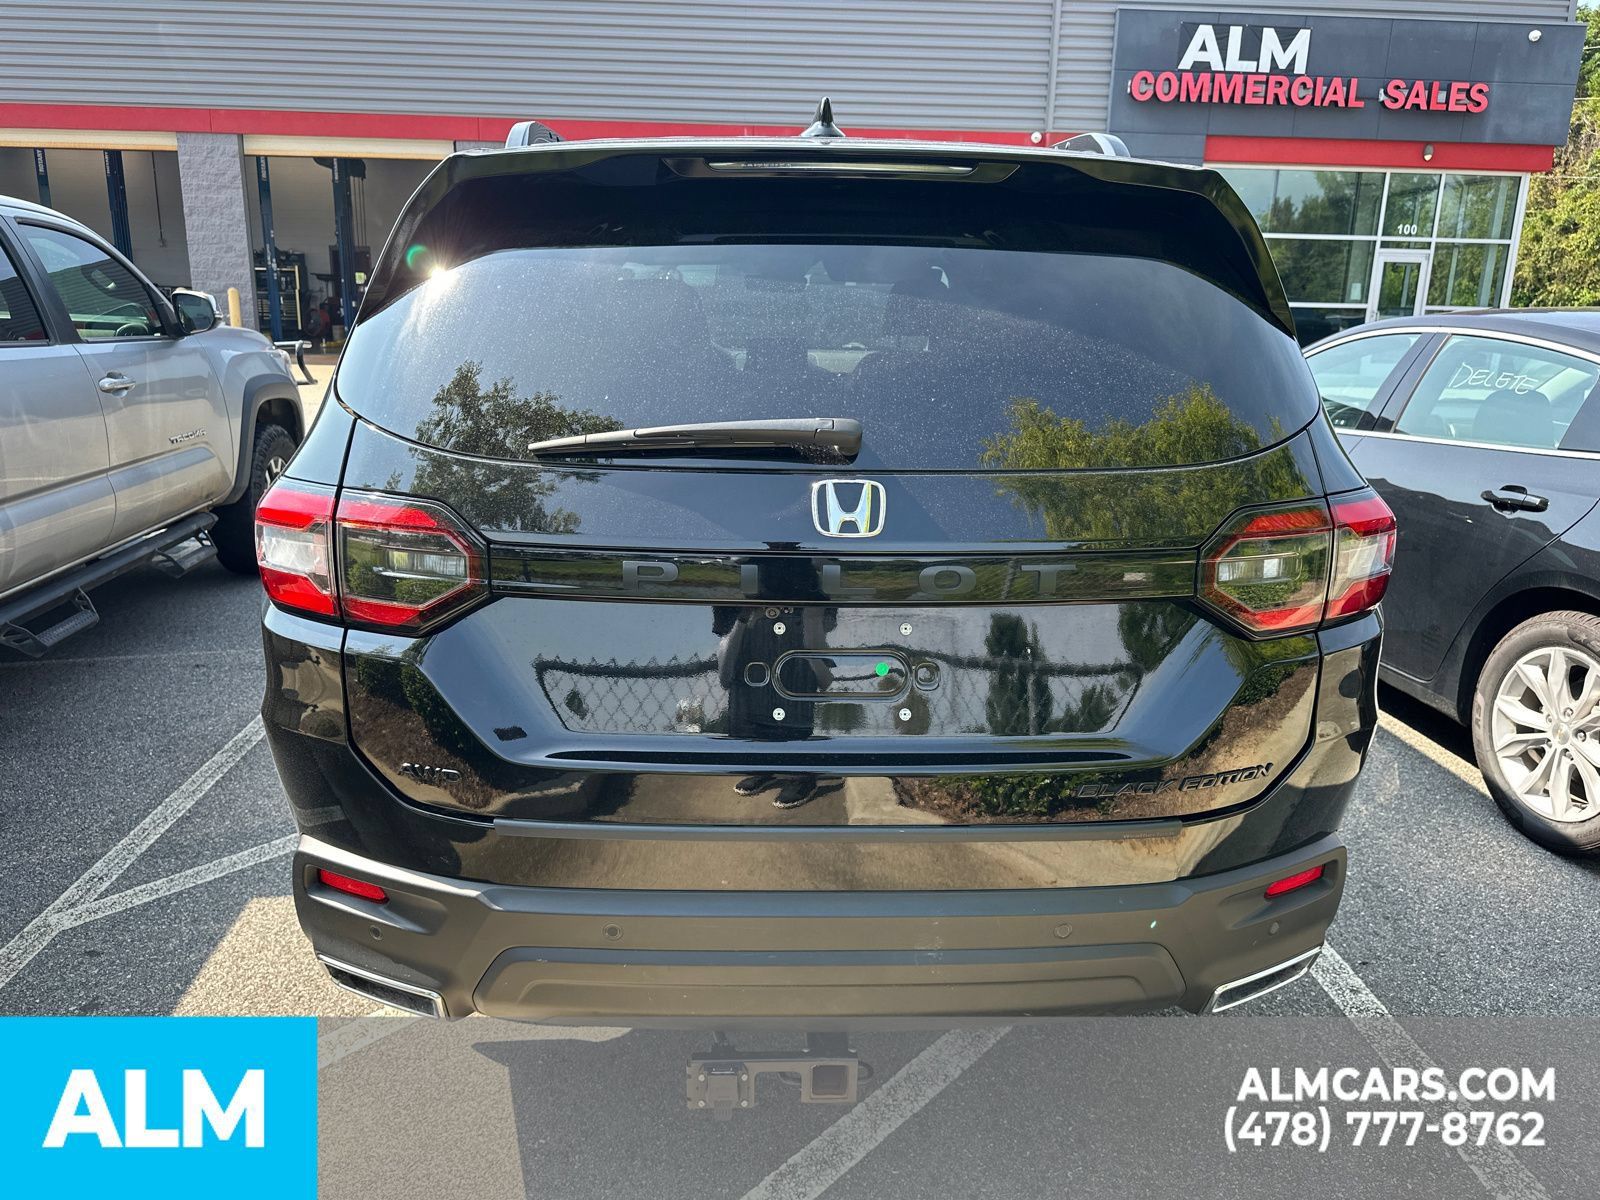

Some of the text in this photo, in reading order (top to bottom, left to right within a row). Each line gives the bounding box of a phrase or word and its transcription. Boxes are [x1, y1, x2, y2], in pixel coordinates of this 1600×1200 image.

[1177, 24, 1312, 75] ALM
[1130, 70, 1490, 113] COMMERCIAL SALES
[1397, 224, 1418, 235] 100
[1448, 361, 1539, 395] DELETE
[169, 428, 207, 444] TACOMA
[622, 560, 1078, 595] PILOT
[398, 762, 461, 784] AWD
[1077, 762, 1274, 798] BLACK EDITION
